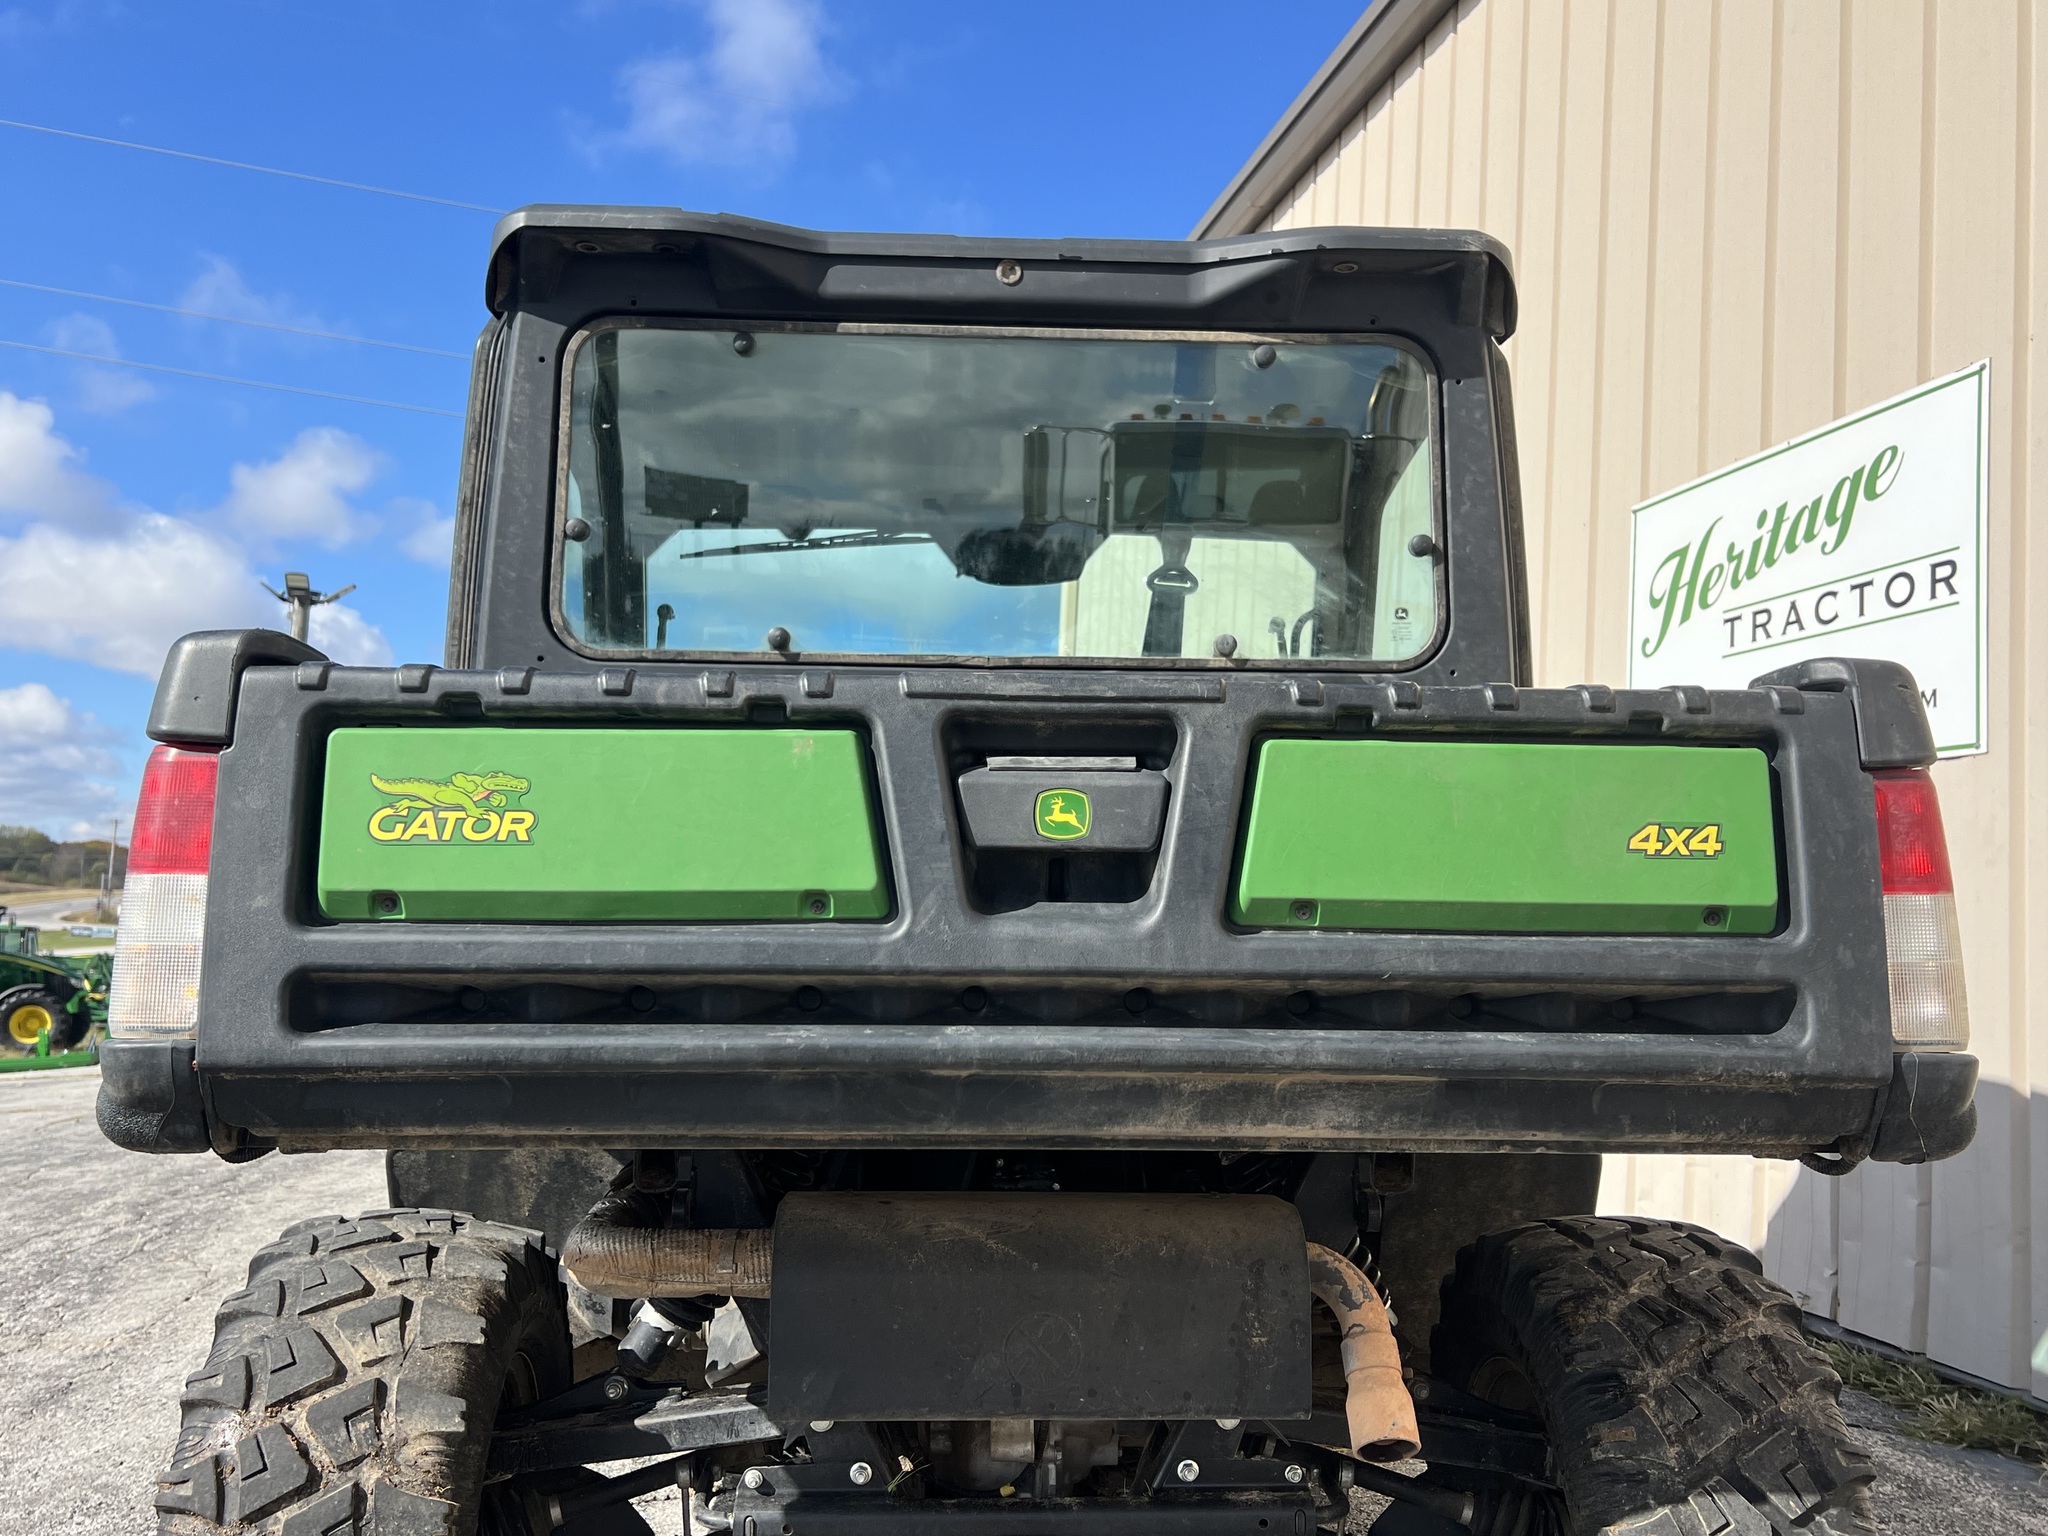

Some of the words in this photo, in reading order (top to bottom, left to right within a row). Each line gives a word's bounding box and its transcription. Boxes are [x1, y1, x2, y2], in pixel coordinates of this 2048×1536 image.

[1641, 444, 1905, 658] Heritage
[1723, 559, 1959, 649] TRACTOR
[368, 807, 536, 842] GATOR
